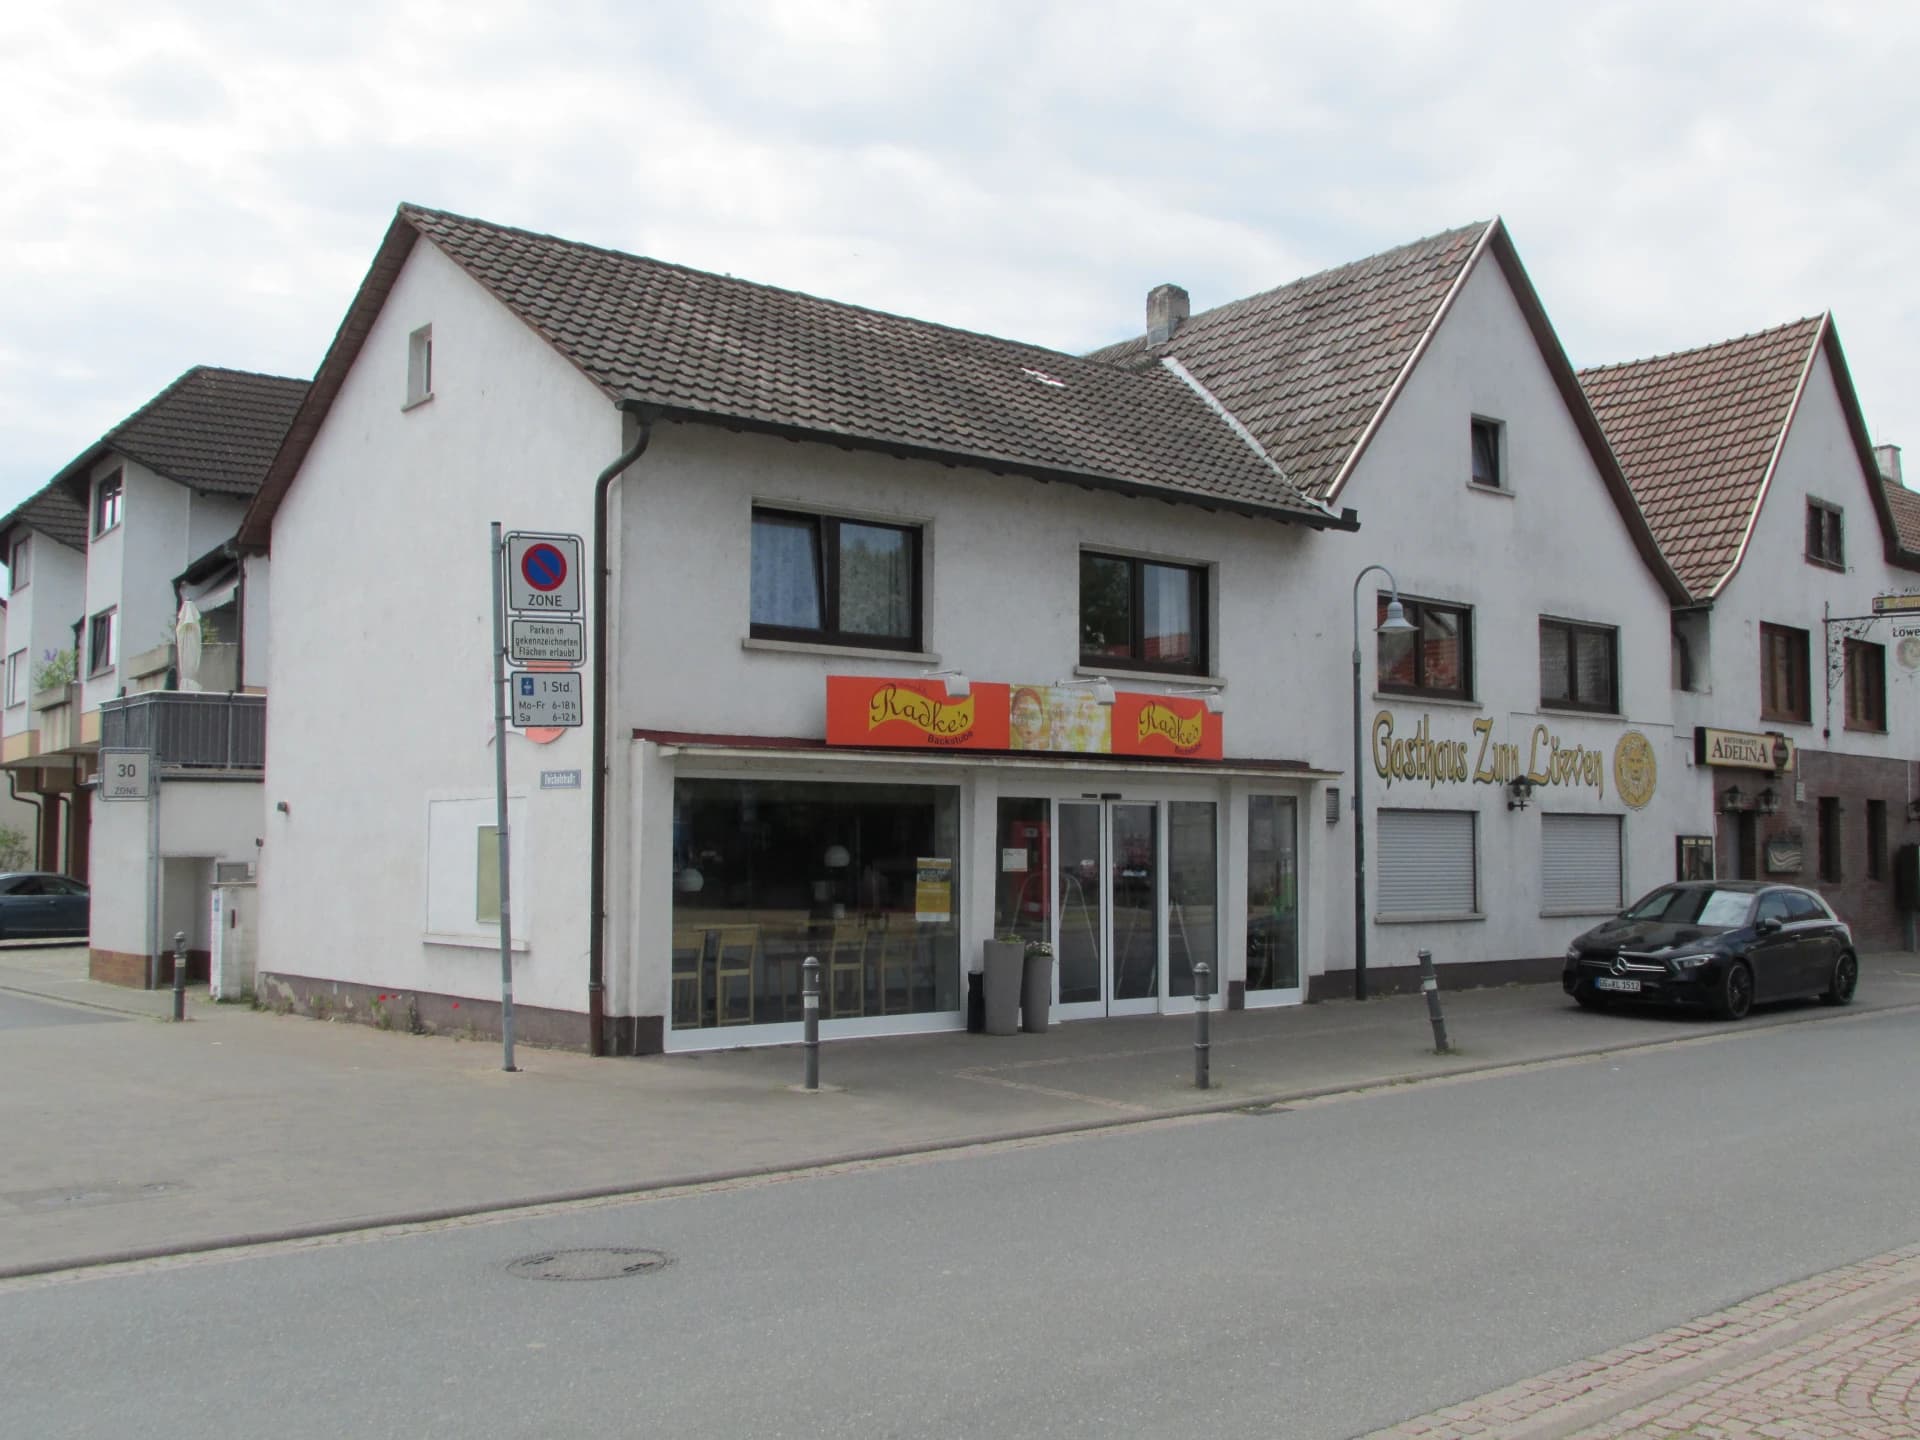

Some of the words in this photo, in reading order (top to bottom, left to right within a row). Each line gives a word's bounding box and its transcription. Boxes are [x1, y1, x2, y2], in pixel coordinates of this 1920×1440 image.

[528, 594, 562, 607] ZONE
[529, 624, 555, 635] Parken
[557, 627, 564, 635] in
[515, 635, 579, 647] gekennzeichneten
[519, 646, 547, 657] Flächen
[549, 647, 575, 658] erlaubt
[519, 701, 545, 711] Mo-Fr
[870, 682, 969, 733] Radke's
[519, 713, 531, 722] Sa
[1372, 710, 1468, 790] Gasthaus
[1472, 717, 1520, 785] Zum
[1526, 723, 1604, 800] Löwen
[1712, 737, 1768, 763] ADELINA
[118, 763, 136, 778] 30
